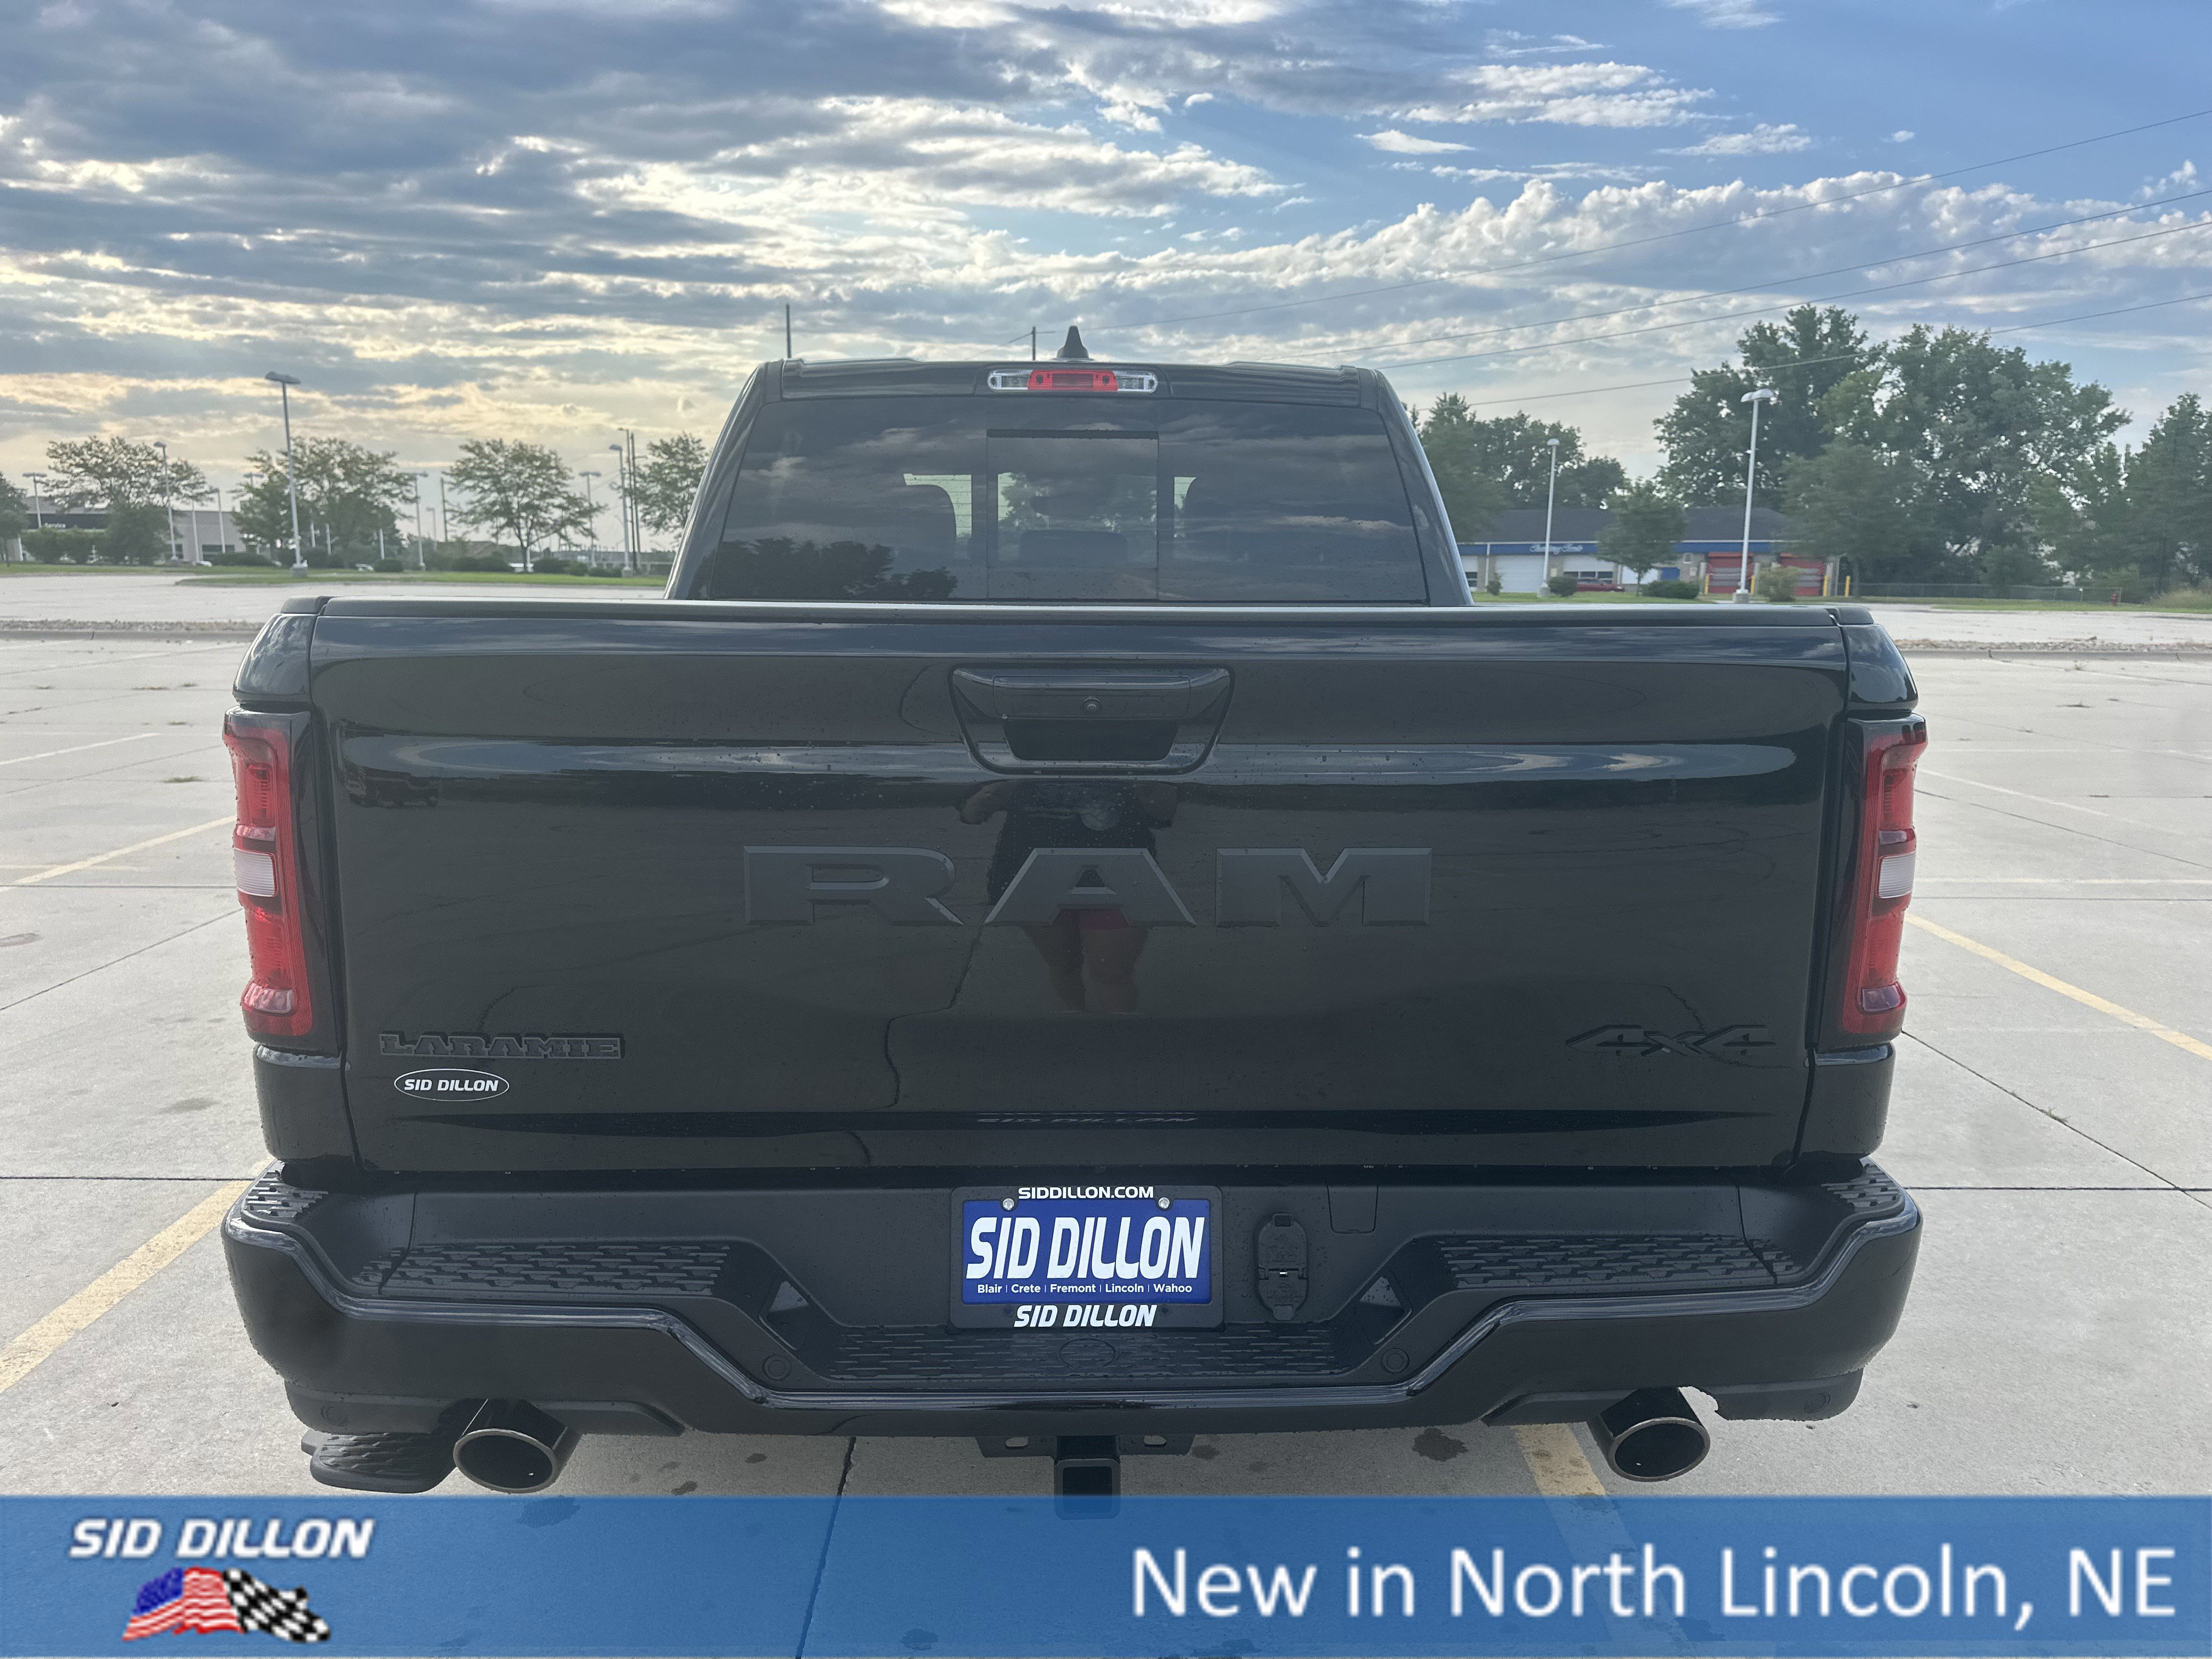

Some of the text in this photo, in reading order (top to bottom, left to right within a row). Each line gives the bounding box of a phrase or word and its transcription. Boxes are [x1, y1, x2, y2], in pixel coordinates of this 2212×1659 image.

[743, 845, 1433, 928] RAM
[379, 1033, 623, 1060] LARAMIE
[404, 1079, 499, 1092] SID DILLON
[1018, 1186, 1154, 1199] SIDDILLON.COM
[966, 1216, 1205, 1279] SID DILLON
[977, 1283, 1193, 1294] Blair Crete Fremont Lincoln Wahoo
[1013, 1304, 1158, 1328] SID DILLON
